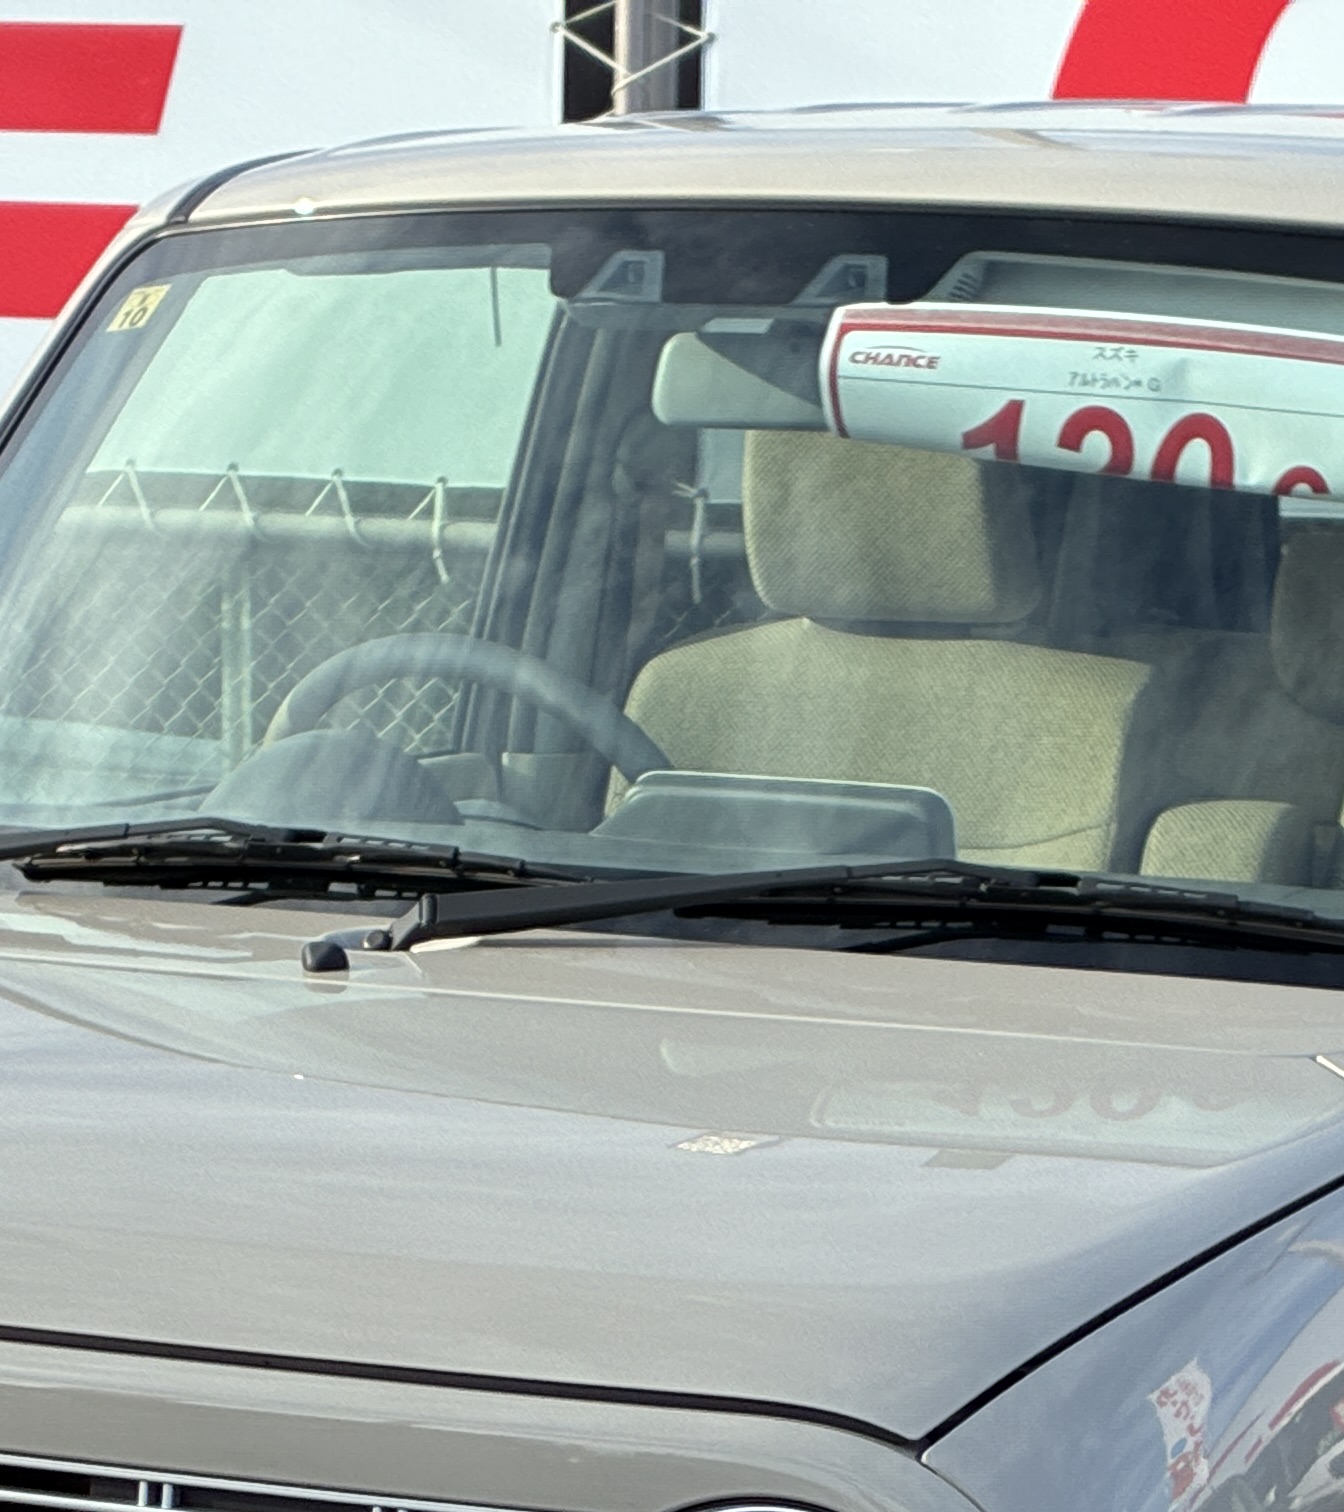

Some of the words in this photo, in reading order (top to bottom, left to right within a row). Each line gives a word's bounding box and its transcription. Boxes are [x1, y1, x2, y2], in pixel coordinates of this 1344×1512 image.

[118, 307, 149, 328] 10
[848, 351, 941, 370] CHANCE
[1092, 346, 1139, 363] スズキ
